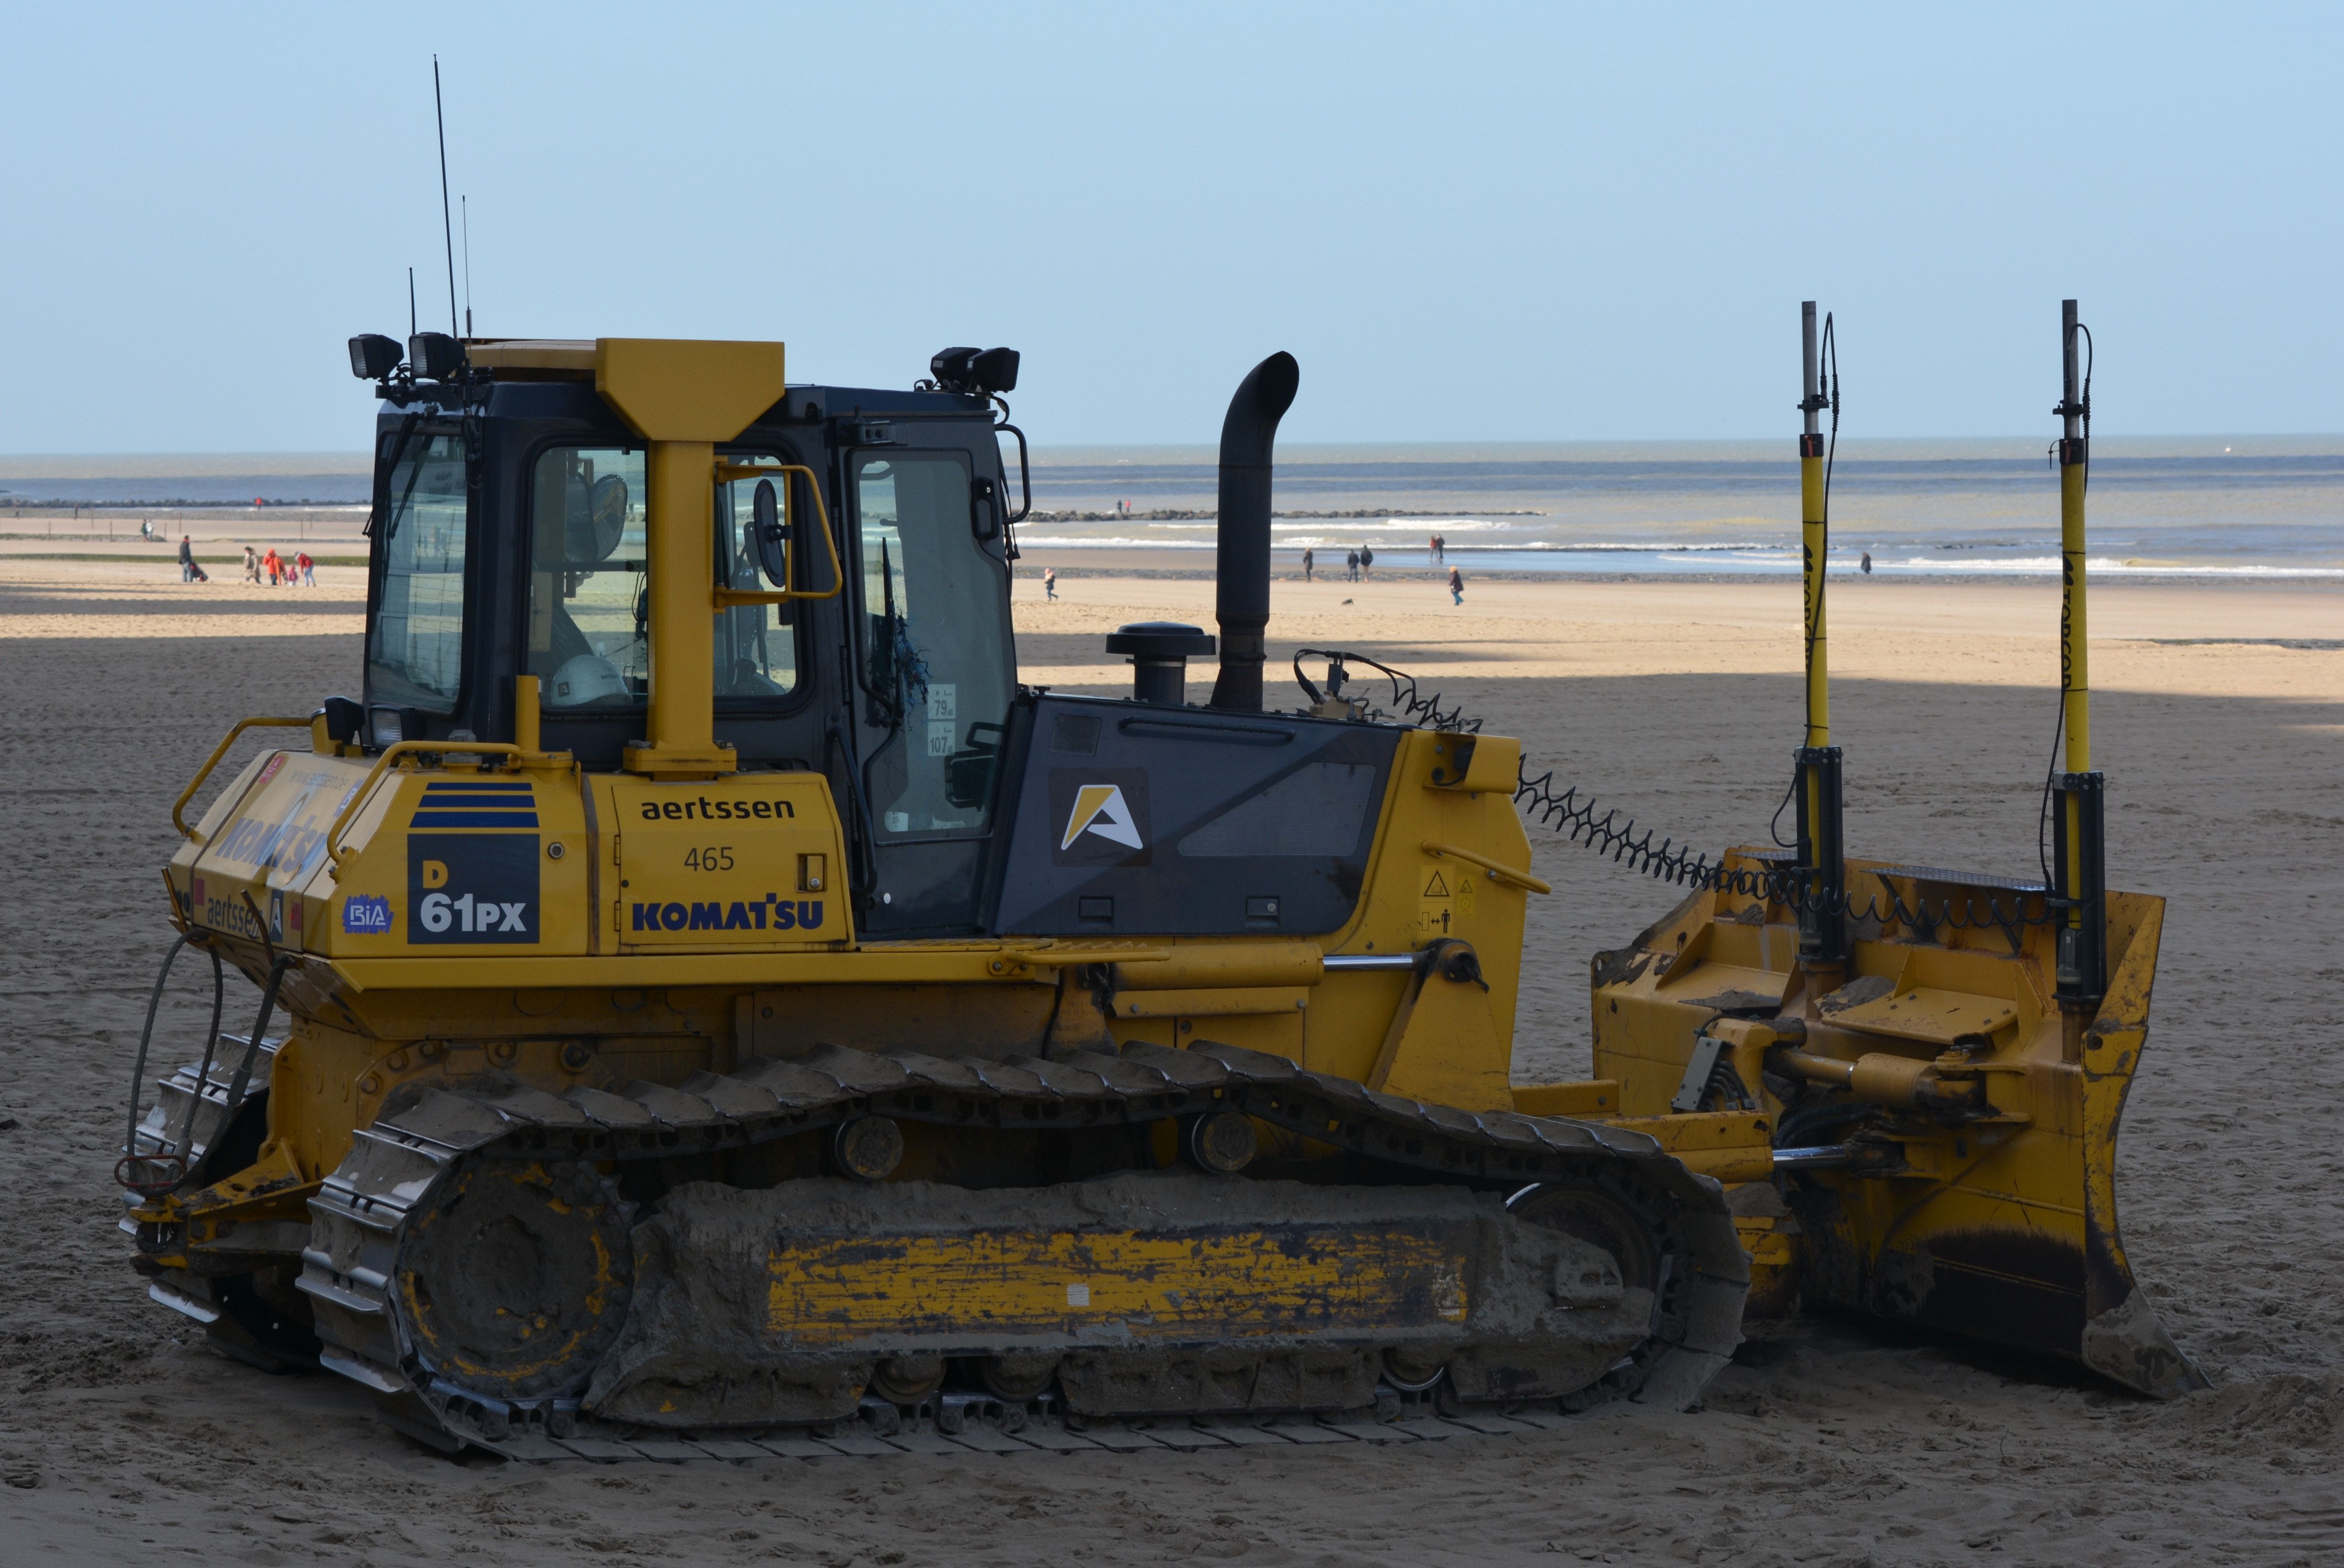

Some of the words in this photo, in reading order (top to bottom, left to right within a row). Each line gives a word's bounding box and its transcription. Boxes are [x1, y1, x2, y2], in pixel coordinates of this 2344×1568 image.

[935, 700, 947, 716] 79
[930, 737, 947, 753] 107
[641, 797, 795, 820] aertssen
[684, 847, 734, 871] 465
[423, 860, 448, 889] D
[421, 893, 527, 932] 61PX
[633, 893, 823, 931] KOMATSU
